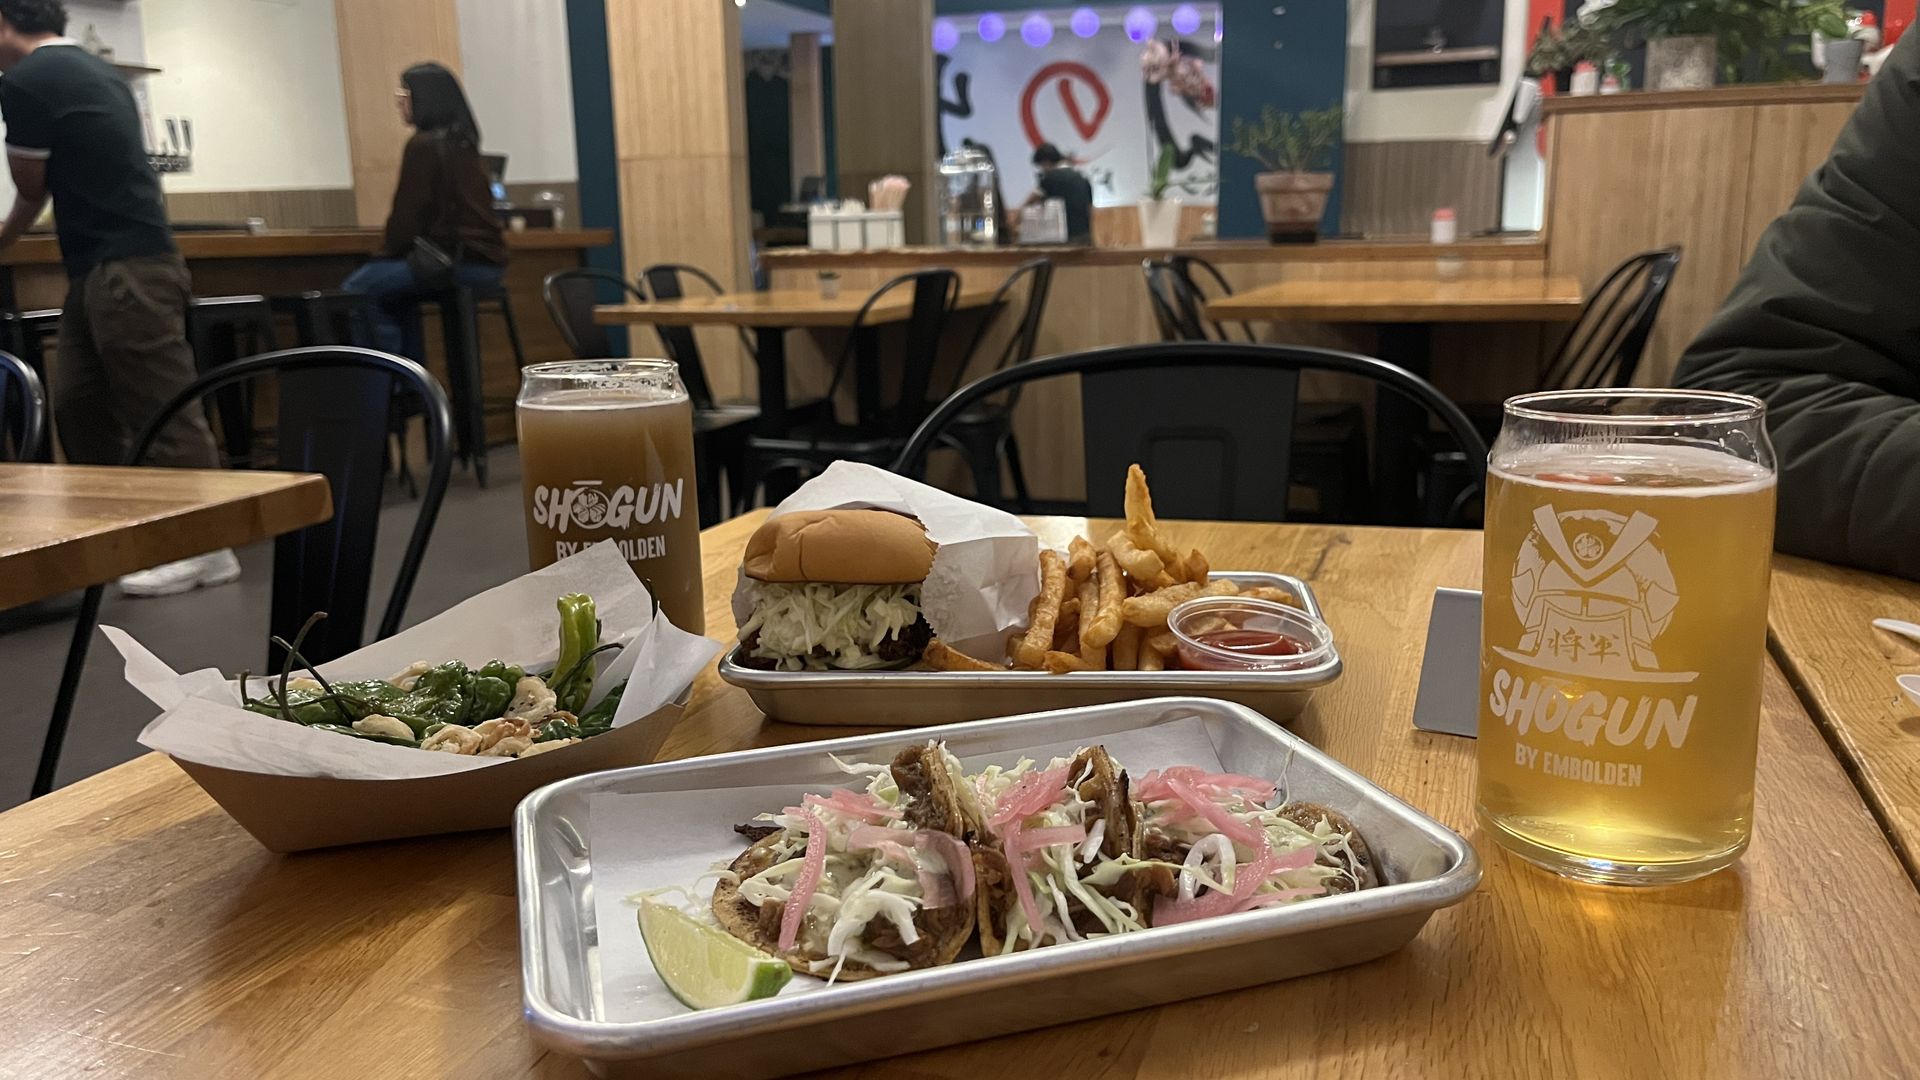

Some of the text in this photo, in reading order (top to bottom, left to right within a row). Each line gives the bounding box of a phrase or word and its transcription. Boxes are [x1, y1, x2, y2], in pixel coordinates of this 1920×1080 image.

[583, 535, 666, 561] OLDEN
[1515, 742, 1643, 787] BY EMBOLDEN
